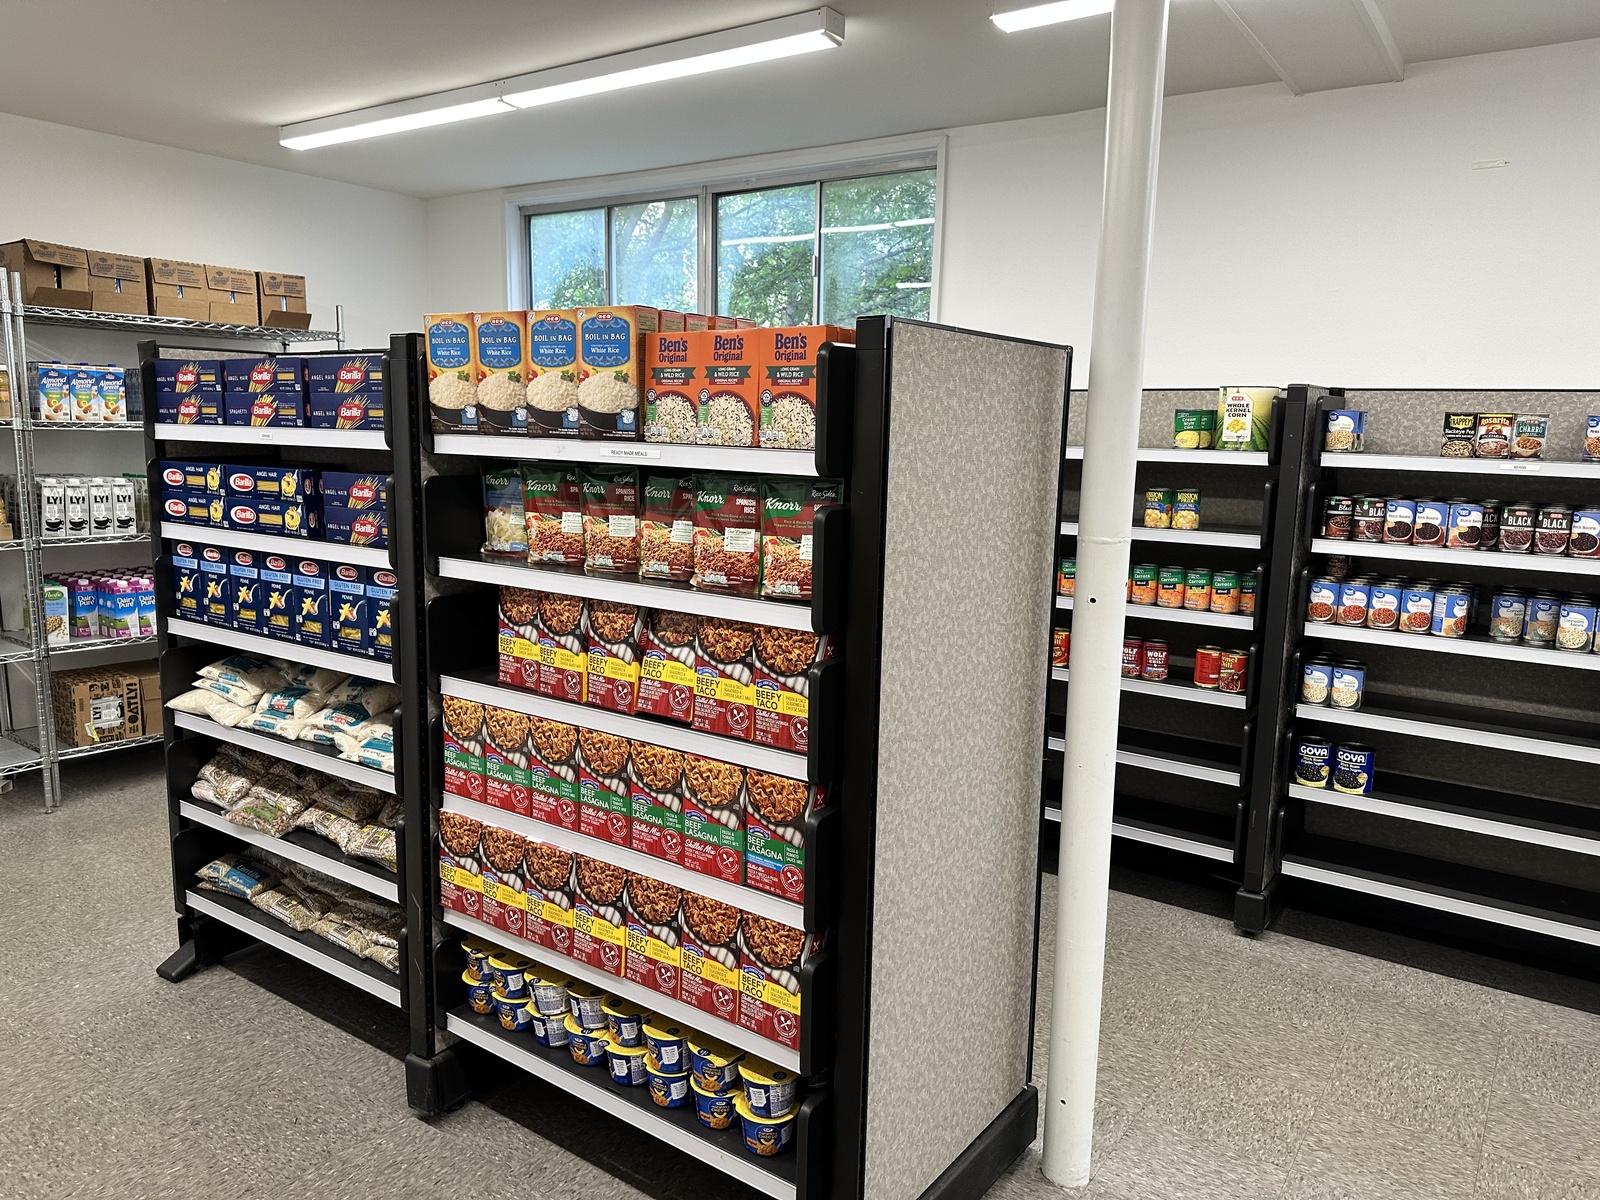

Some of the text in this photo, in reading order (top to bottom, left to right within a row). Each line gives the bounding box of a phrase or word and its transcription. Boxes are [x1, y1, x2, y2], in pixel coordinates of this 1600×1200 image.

[659, 337, 688, 353] Ben's
[714, 334, 744, 350] Ben's
[775, 333, 807, 350] Ben's
[659, 352, 687, 364] Original
[713, 350, 743, 363] Original
[775, 350, 806, 362] Original
[253, 372, 271, 380] Barilla
[340, 371, 361, 379] Barilla
[99, 379, 122, 387] Almond
[254, 406, 272, 415] Barilla
[341, 408, 361, 416] Barilla
[1481, 417, 1509, 426] Rosarita
[486, 475, 509, 486] Knorr
[526, 480, 558, 491] Knorr
[352, 488, 373, 497] Barilla
[583, 483, 605, 493] Knorr
[644, 486, 671, 498] Knorr
[47, 496, 62, 504] LY!
[70, 496, 85, 504] LY!
[94, 495, 109, 503] LY!
[696, 491, 725, 504] Knorr
[744, 506, 756, 514] RICE
[765, 498, 801, 511] Knorr
[1369, 508, 1384, 516] BLAC
[1508, 516, 1532, 526] BLACK
[1543, 518, 1567, 529] BLACK
[355, 524, 375, 533] Barilla
[540, 647, 557, 656] BEEFY
[540, 655, 555, 664] TACO
[589, 656, 608, 666] BEEFY
[644, 660, 667, 670] BEEFY
[643, 669, 662, 678] TACO
[696, 677, 720, 688] BEEFY
[696, 687, 716, 696] TACO
[756, 690, 781, 702] BEEFY
[756, 699, 778, 710] TACO
[93, 707, 101, 720] LY!
[1301, 746, 1328, 756] GOYA
[1338, 751, 1365, 762] GOYA
[444, 758, 468, 770] LASAGNA
[487, 761, 500, 770] BEEF
[487, 769, 512, 782] LASAGNA
[532, 774, 545, 784] BEEF
[532, 782, 559, 795] LASAGNA
[580, 787, 595, 797] BEEF
[580, 796, 609, 809] LASAGNA
[632, 803, 647, 812] BEEF
[632, 811, 663, 826] LASAGNA
[685, 819, 702, 830] BEEF
[685, 828, 718, 843] LASAGNA
[748, 835, 765, 846] BEEF
[747, 844, 783, 861] LASAGNA
[237, 863, 261, 880] Lentils
[628, 932, 649, 946] BEEFY
[628, 942, 645, 954] TACO
[683, 951, 706, 967] BEEFY
[683, 962, 702, 975] TACO
[742, 974, 767, 991] BEEFY
[742, 982, 762, 998] TACO
